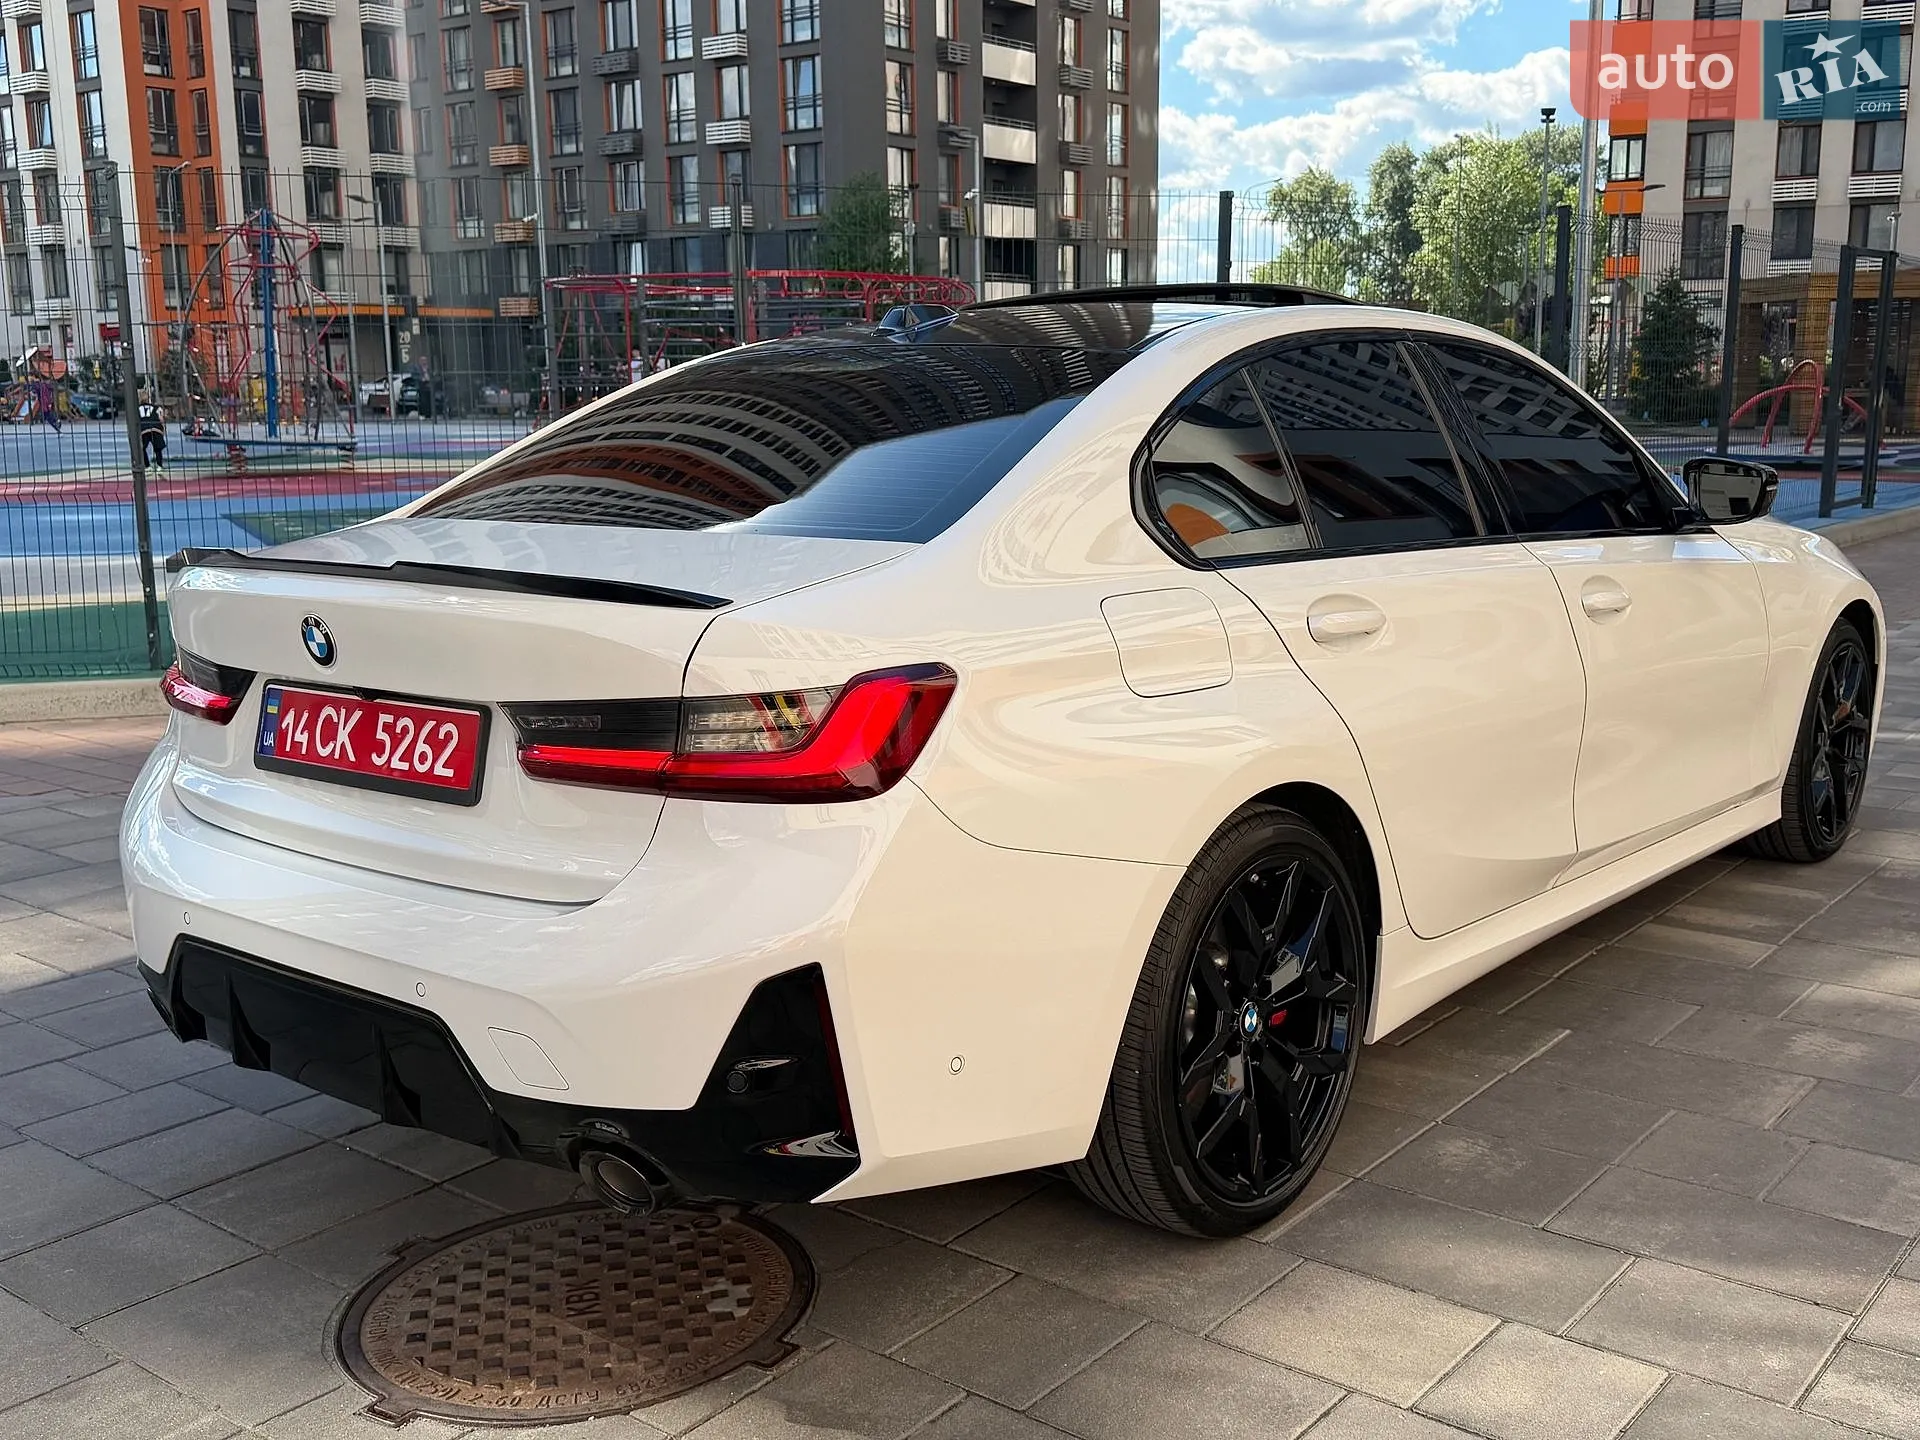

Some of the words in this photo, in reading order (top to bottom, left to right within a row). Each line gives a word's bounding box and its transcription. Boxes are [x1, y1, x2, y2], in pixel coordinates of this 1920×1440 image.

[398, 331, 411, 344] 20
[263, 731, 275, 748] UA
[371, 711, 459, 778] 5262
